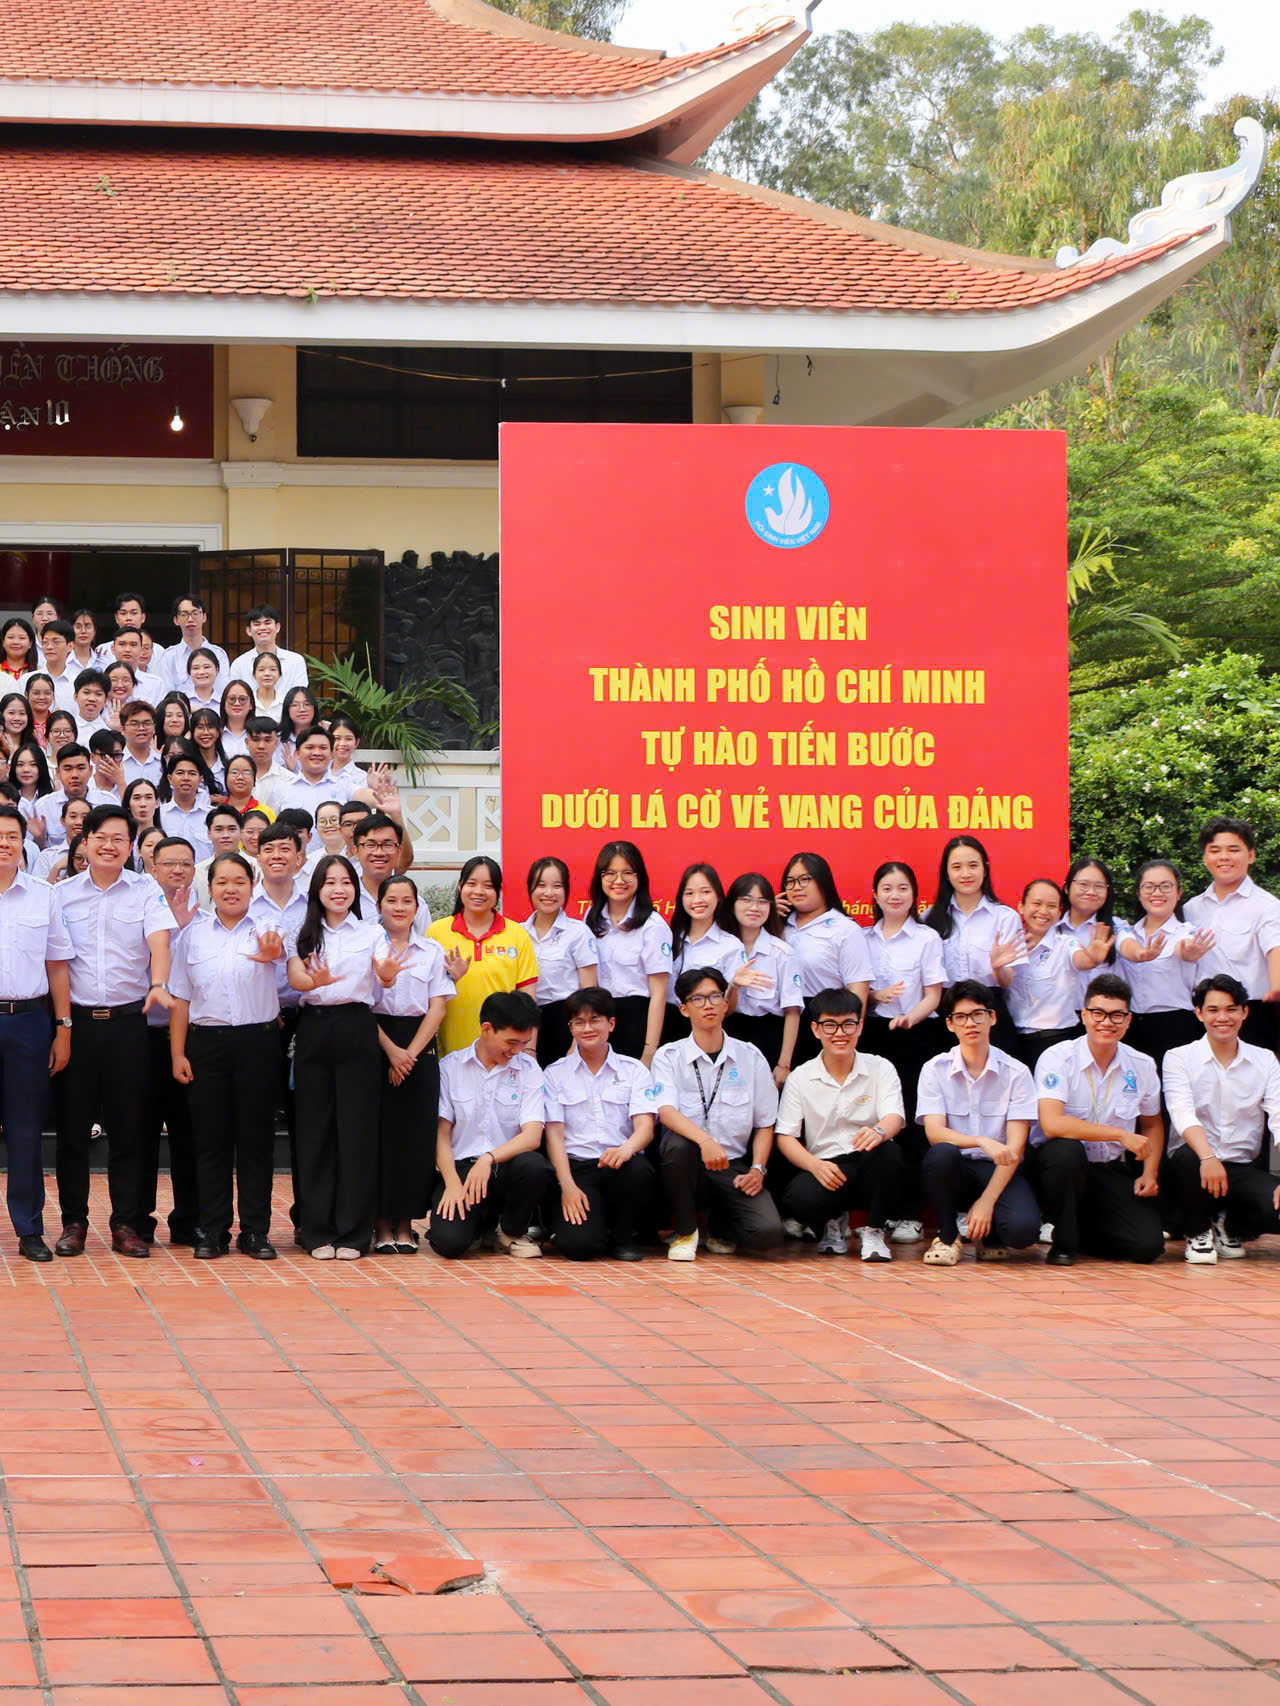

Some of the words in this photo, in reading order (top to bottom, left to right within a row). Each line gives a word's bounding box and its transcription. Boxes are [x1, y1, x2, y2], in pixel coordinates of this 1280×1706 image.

[46, 399, 71, 427] 10
[709, 605, 786, 641] SINH
[795, 600, 867, 641] VIÊN
[588, 660, 696, 703] THÀNH
[706, 657, 771, 704] PHỐ
[781, 657, 825, 704] HỒ
[836, 663, 892, 704] CHÍ
[902, 669, 985, 705] MINH
[640, 725, 686, 772] TỰ
[693, 725, 758, 767] HÀO
[767, 719, 837, 766] TIẾN
[847, 725, 935, 767] BƯỚC
[541, 787, 620, 829] DƯỚI
[631, 788, 668, 829] LÁ
[677, 787, 722, 829] CỜ
[730, 785, 770, 829] VẺ
[778, 794, 863, 830] VANG
[873, 786, 939, 830] CỦA
[946, 786, 1034, 830] ĐẢNG
